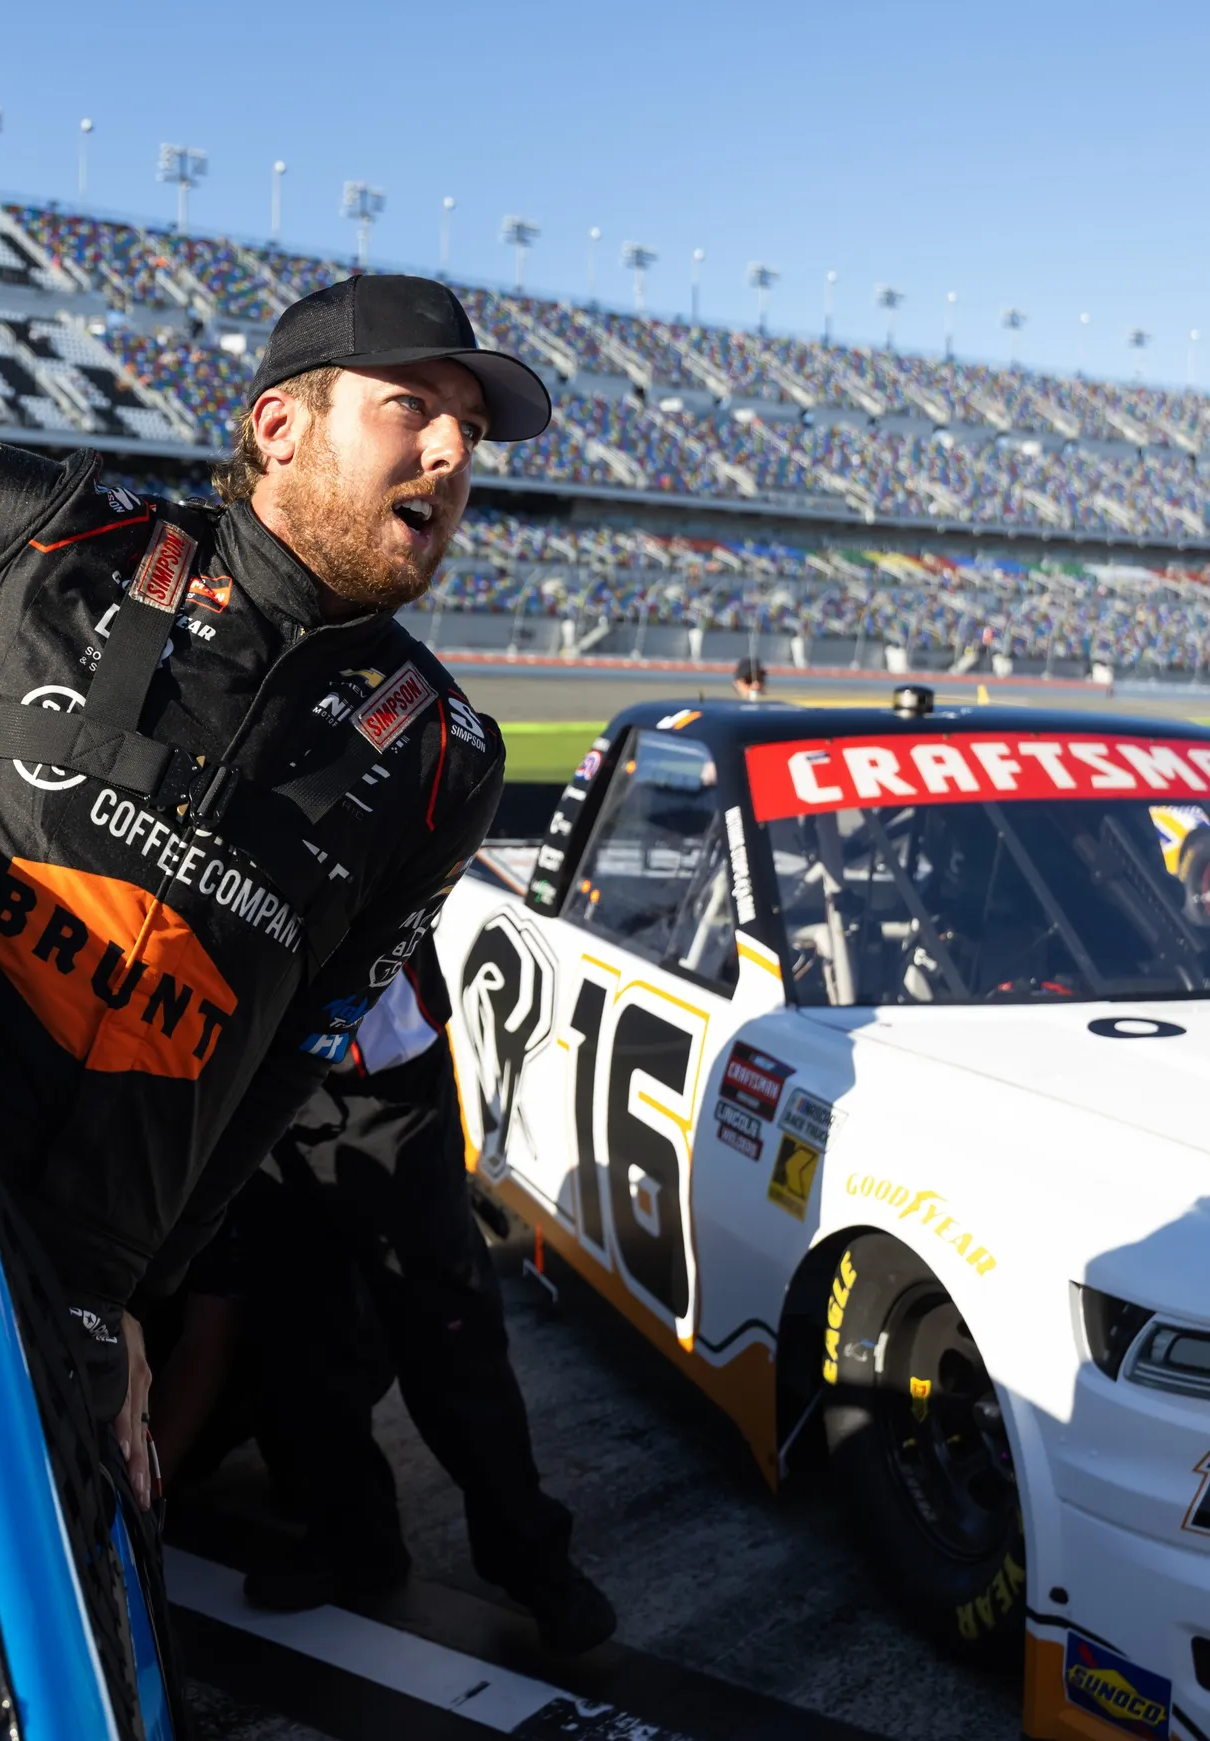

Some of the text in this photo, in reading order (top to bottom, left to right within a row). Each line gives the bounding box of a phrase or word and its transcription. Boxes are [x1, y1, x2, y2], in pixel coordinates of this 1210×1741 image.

[147, 533, 185, 600] SIMPSON
[366, 677, 422, 738] SIMPSON
[450, 724, 486, 753] SIMPSON
[90, 788, 206, 886] COFFEE
[198, 858, 306, 953] COMPAN
[570, 977, 693, 1319] 16
[846, 1172, 997, 1276] GOODYEAR
[823, 1250, 857, 1384] EAGLE
[1070, 1667, 1164, 1725] SUNOCO
